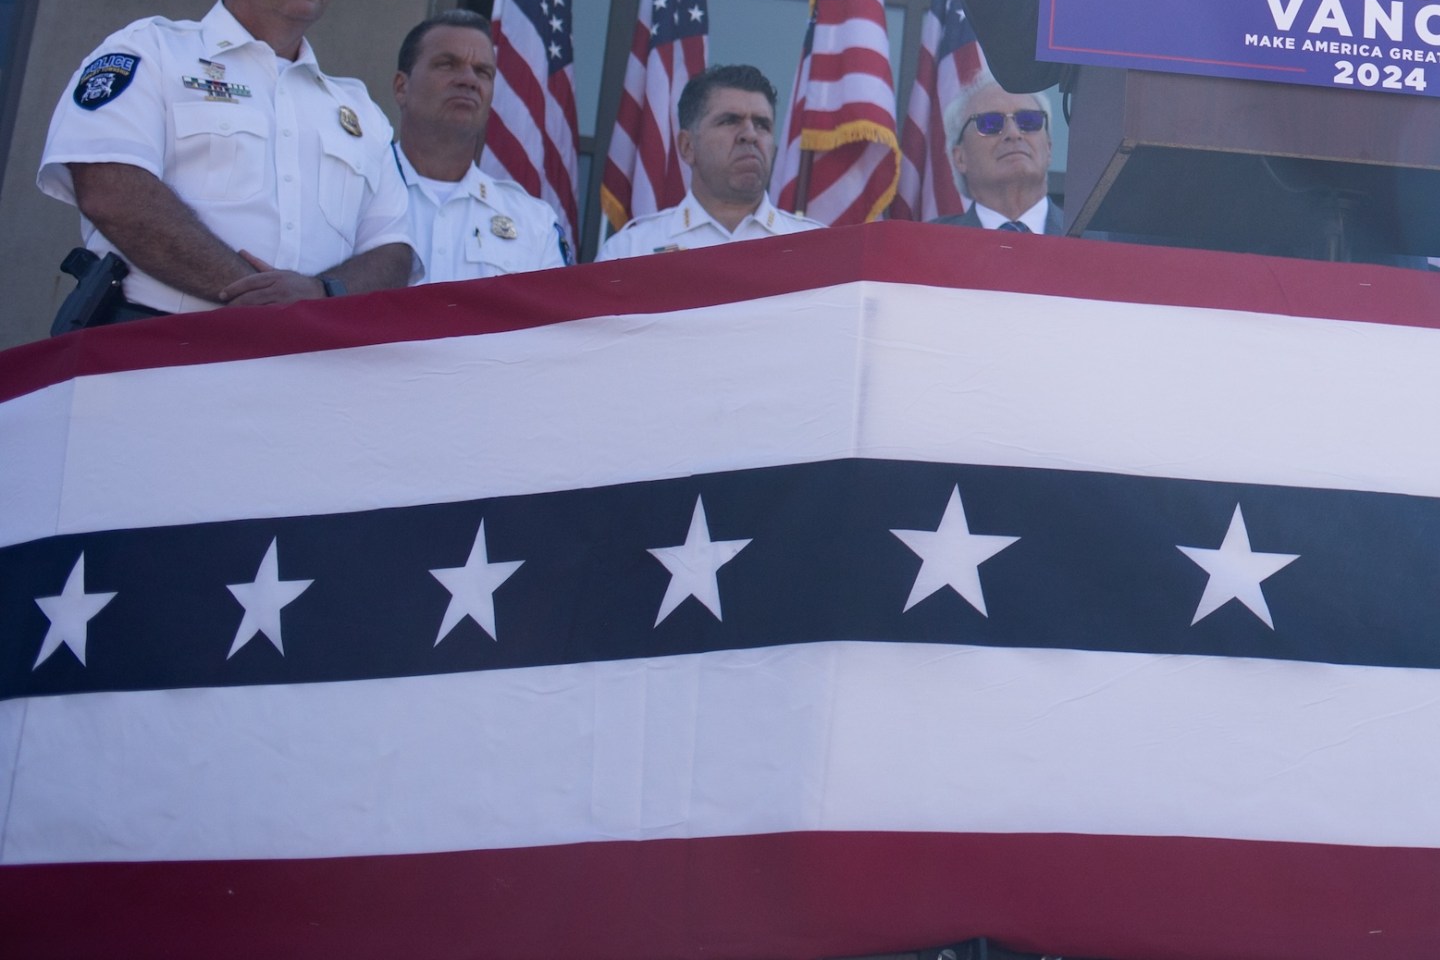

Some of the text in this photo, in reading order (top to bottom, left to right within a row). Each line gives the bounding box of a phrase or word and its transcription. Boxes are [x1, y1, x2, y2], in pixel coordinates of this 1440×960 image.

[1245, 33, 1296, 50] MAKE
[1302, 39, 1383, 58] AMERICA
[1334, 60, 1427, 91] 2024
